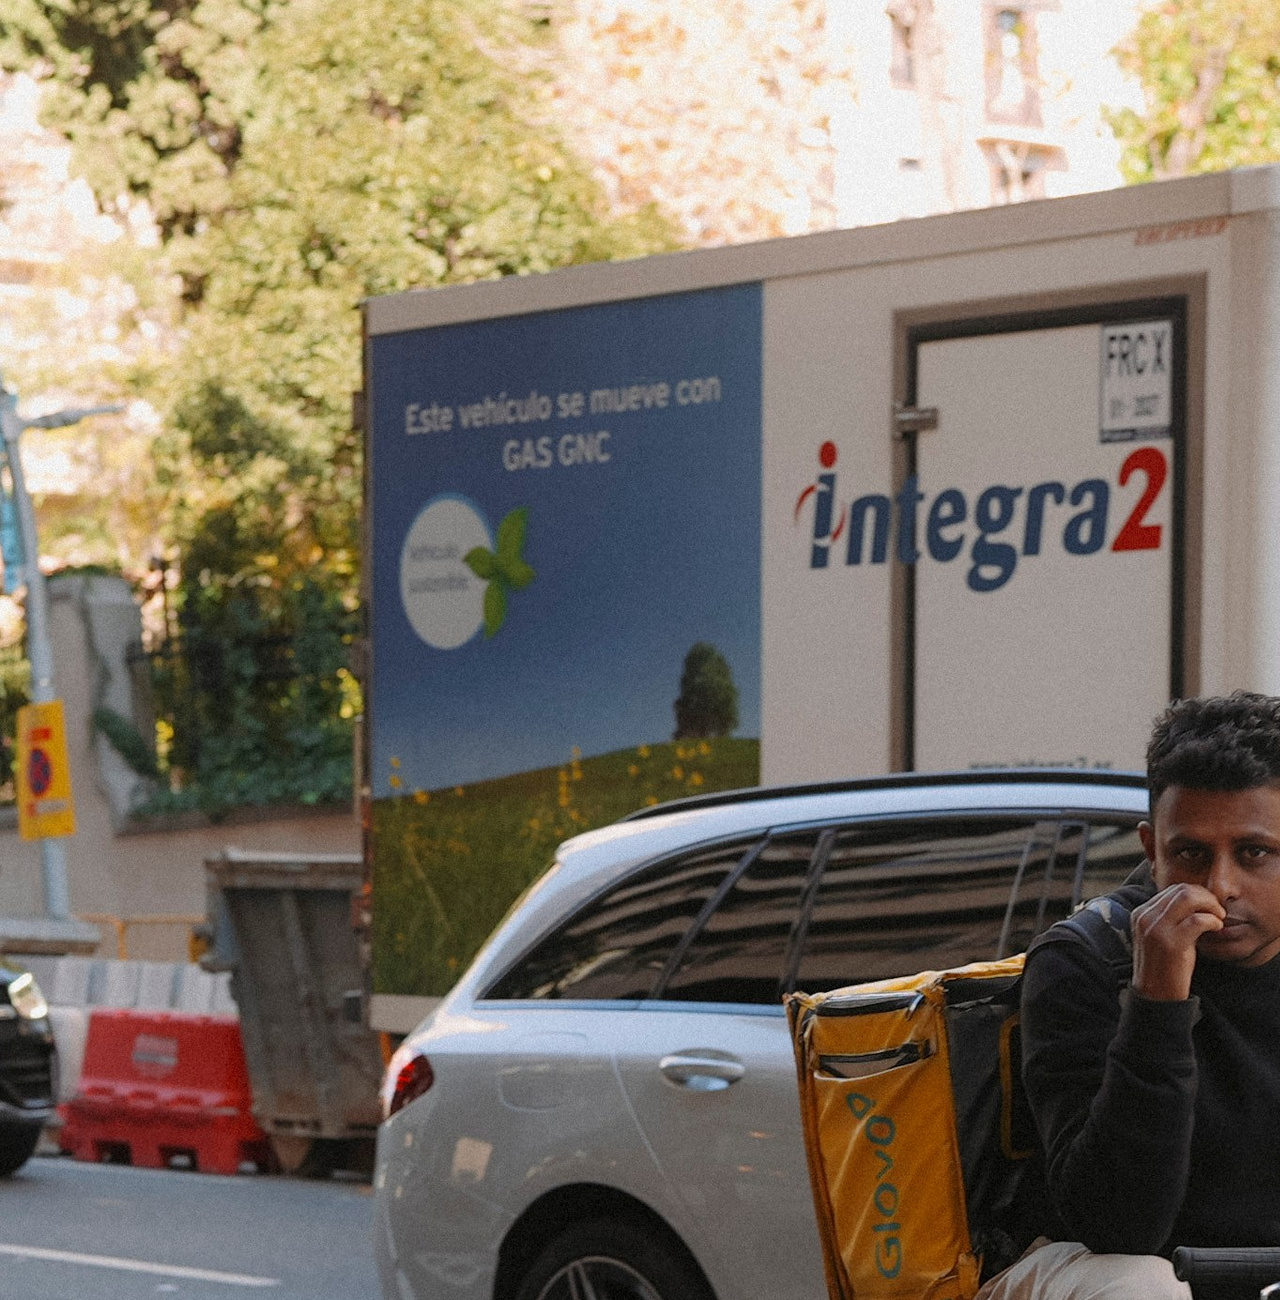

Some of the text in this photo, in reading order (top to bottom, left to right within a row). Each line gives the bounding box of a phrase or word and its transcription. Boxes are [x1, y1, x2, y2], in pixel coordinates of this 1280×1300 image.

[405, 377, 722, 435] Este vehículo se mueve con
[503, 430, 613, 472] GAS GNC
[809, 440, 1169, 593] integra2
